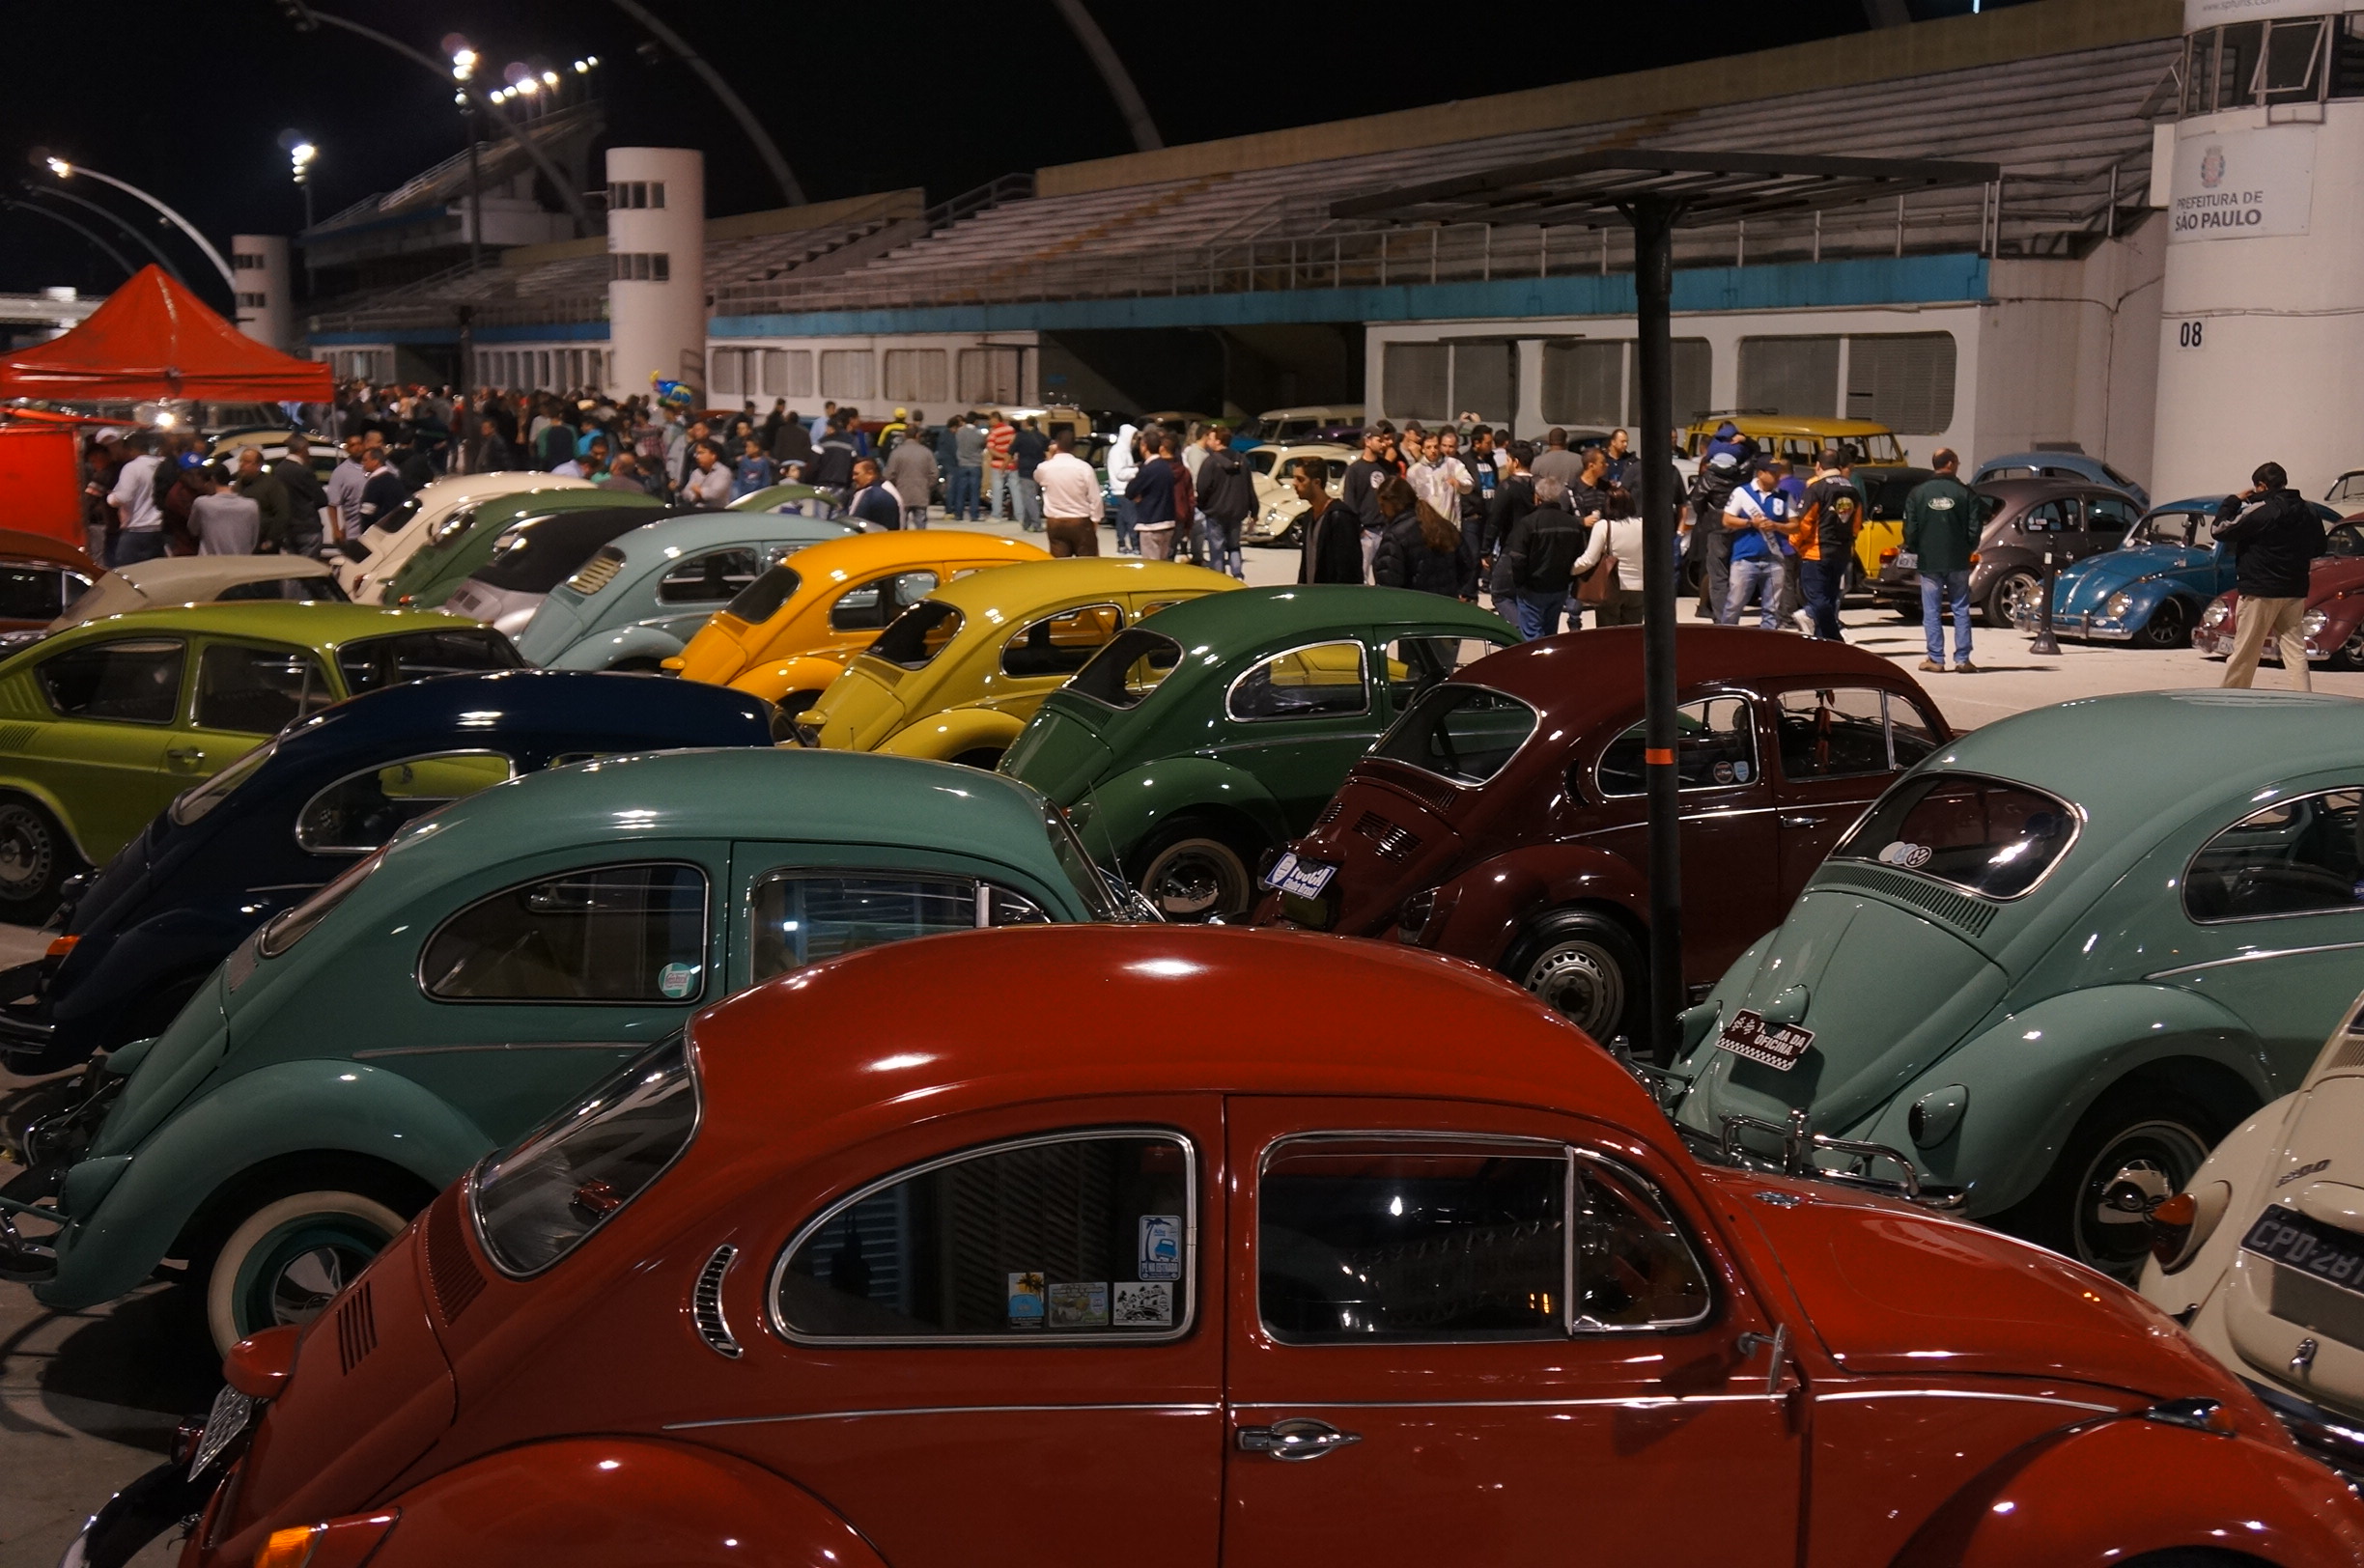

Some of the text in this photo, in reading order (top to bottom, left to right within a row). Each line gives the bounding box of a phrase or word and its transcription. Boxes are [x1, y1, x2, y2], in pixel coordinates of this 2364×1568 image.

[2177, 190, 2265, 210] PREFEITURA DE
[2175, 209, 2262, 232] SÃO PAULO
[2180, 322, 2202, 348] 08
[1790, 1034, 1807, 1048] DA
